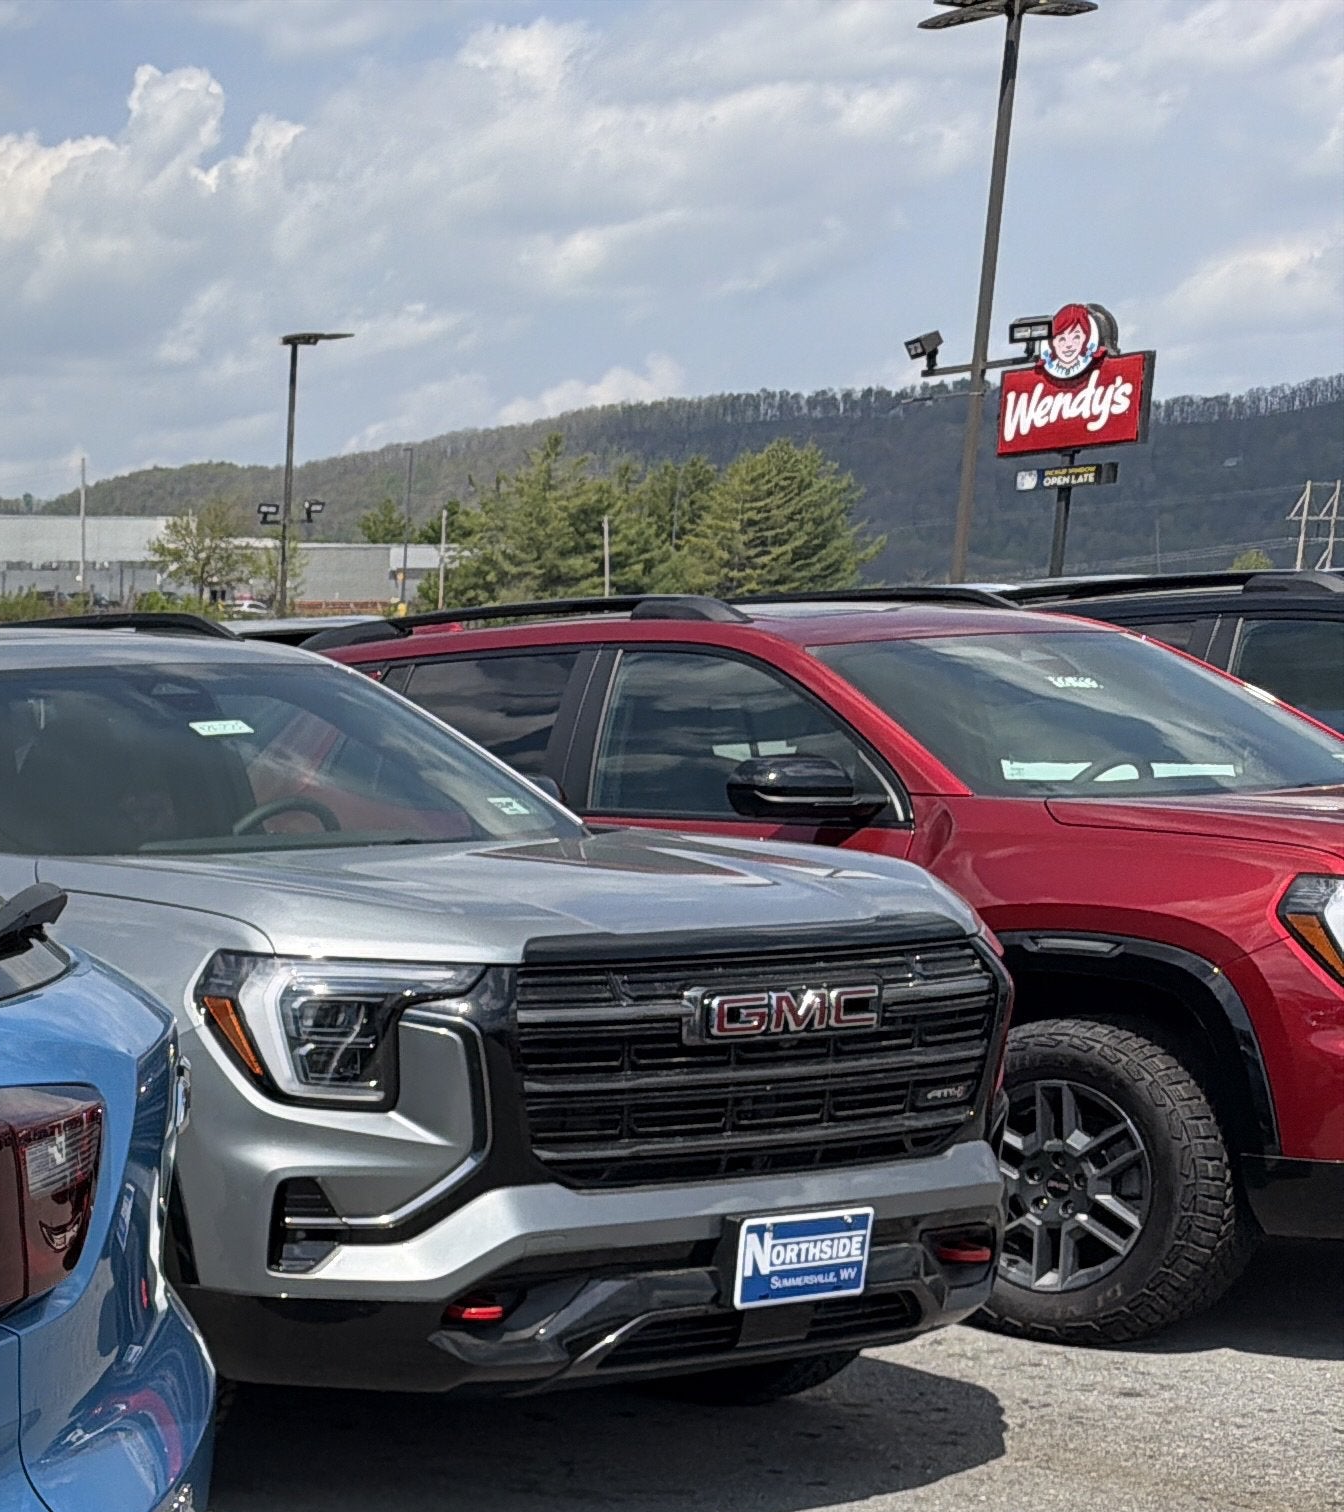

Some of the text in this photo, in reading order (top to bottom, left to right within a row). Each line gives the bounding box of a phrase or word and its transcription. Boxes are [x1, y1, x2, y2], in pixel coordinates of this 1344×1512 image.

[1002, 369, 1134, 442] Wendy's
[1043, 472, 1095, 487] OPEN LATE
[710, 983, 880, 1036] GMC
[744, 1231, 864, 1277] NORTHSIDE
[840, 1267, 858, 1281] WV
